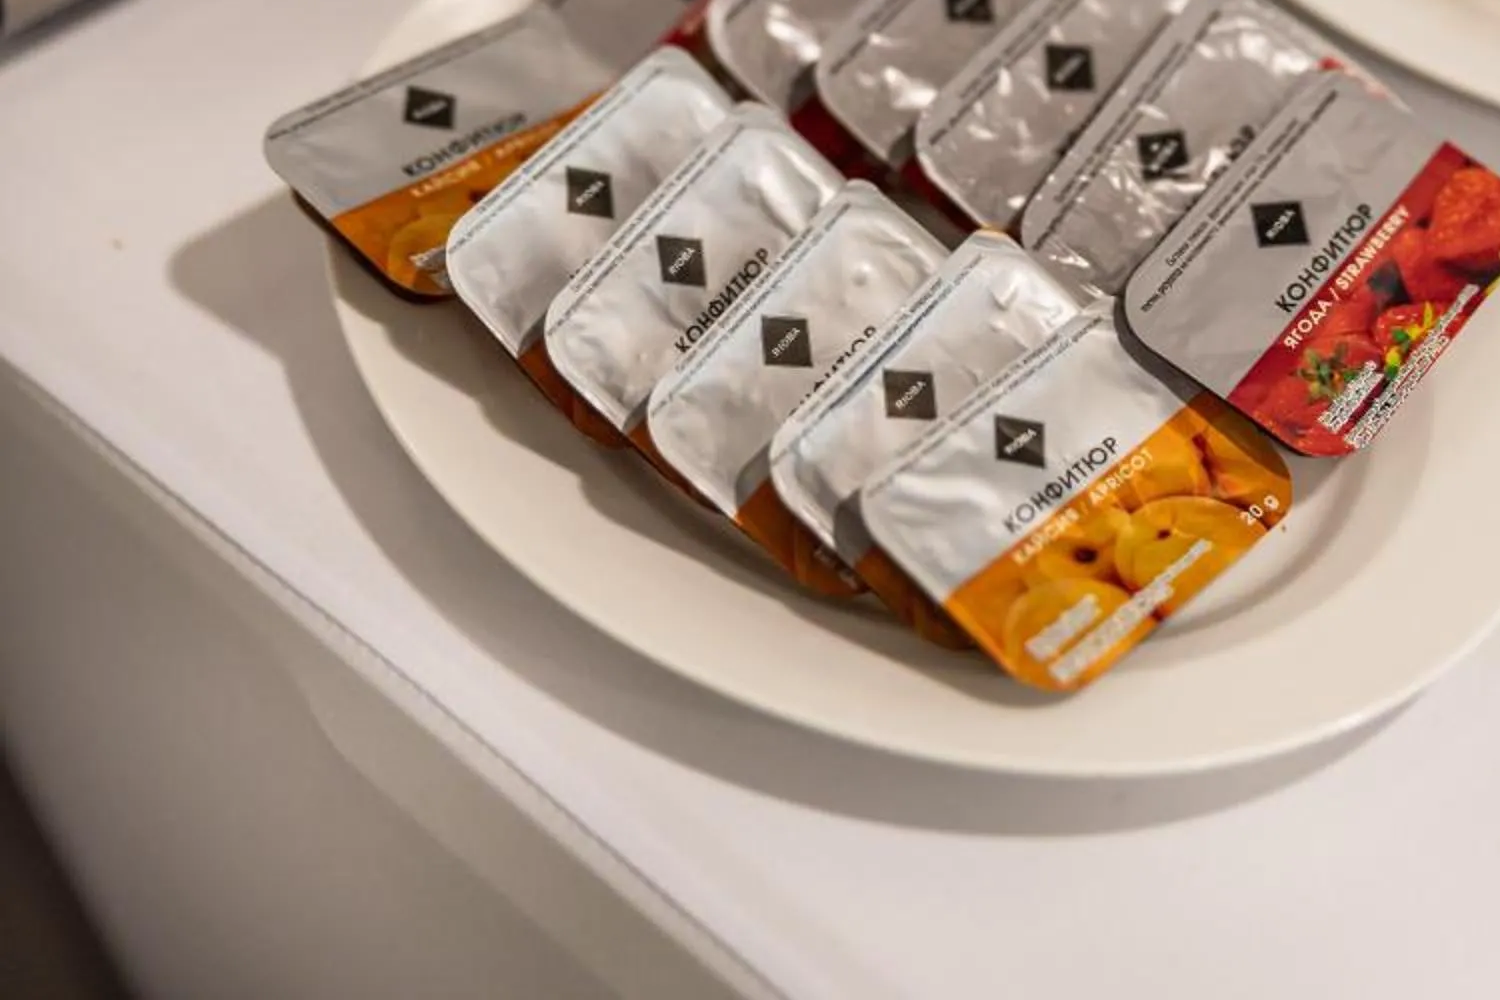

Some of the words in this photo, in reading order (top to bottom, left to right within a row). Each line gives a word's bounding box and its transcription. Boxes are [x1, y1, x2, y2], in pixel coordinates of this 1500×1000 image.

[1266, 209, 1296, 240] RIOBA
[1275, 203, 1374, 313] КОНФИТЮР
[1284, 300, 1333, 350] ЯГОДА
[1337, 205, 1411, 291] STRAWBERRY
[674, 248, 769, 353] КОНФИТЮР
[771, 327, 800, 357] RIOBA
[895, 380, 926, 410] RIOBA
[1004, 436, 1119, 534] КОНФИТЮР
[1088, 447, 1154, 506] APRICOT
[1241, 505, 1263, 527] 20
